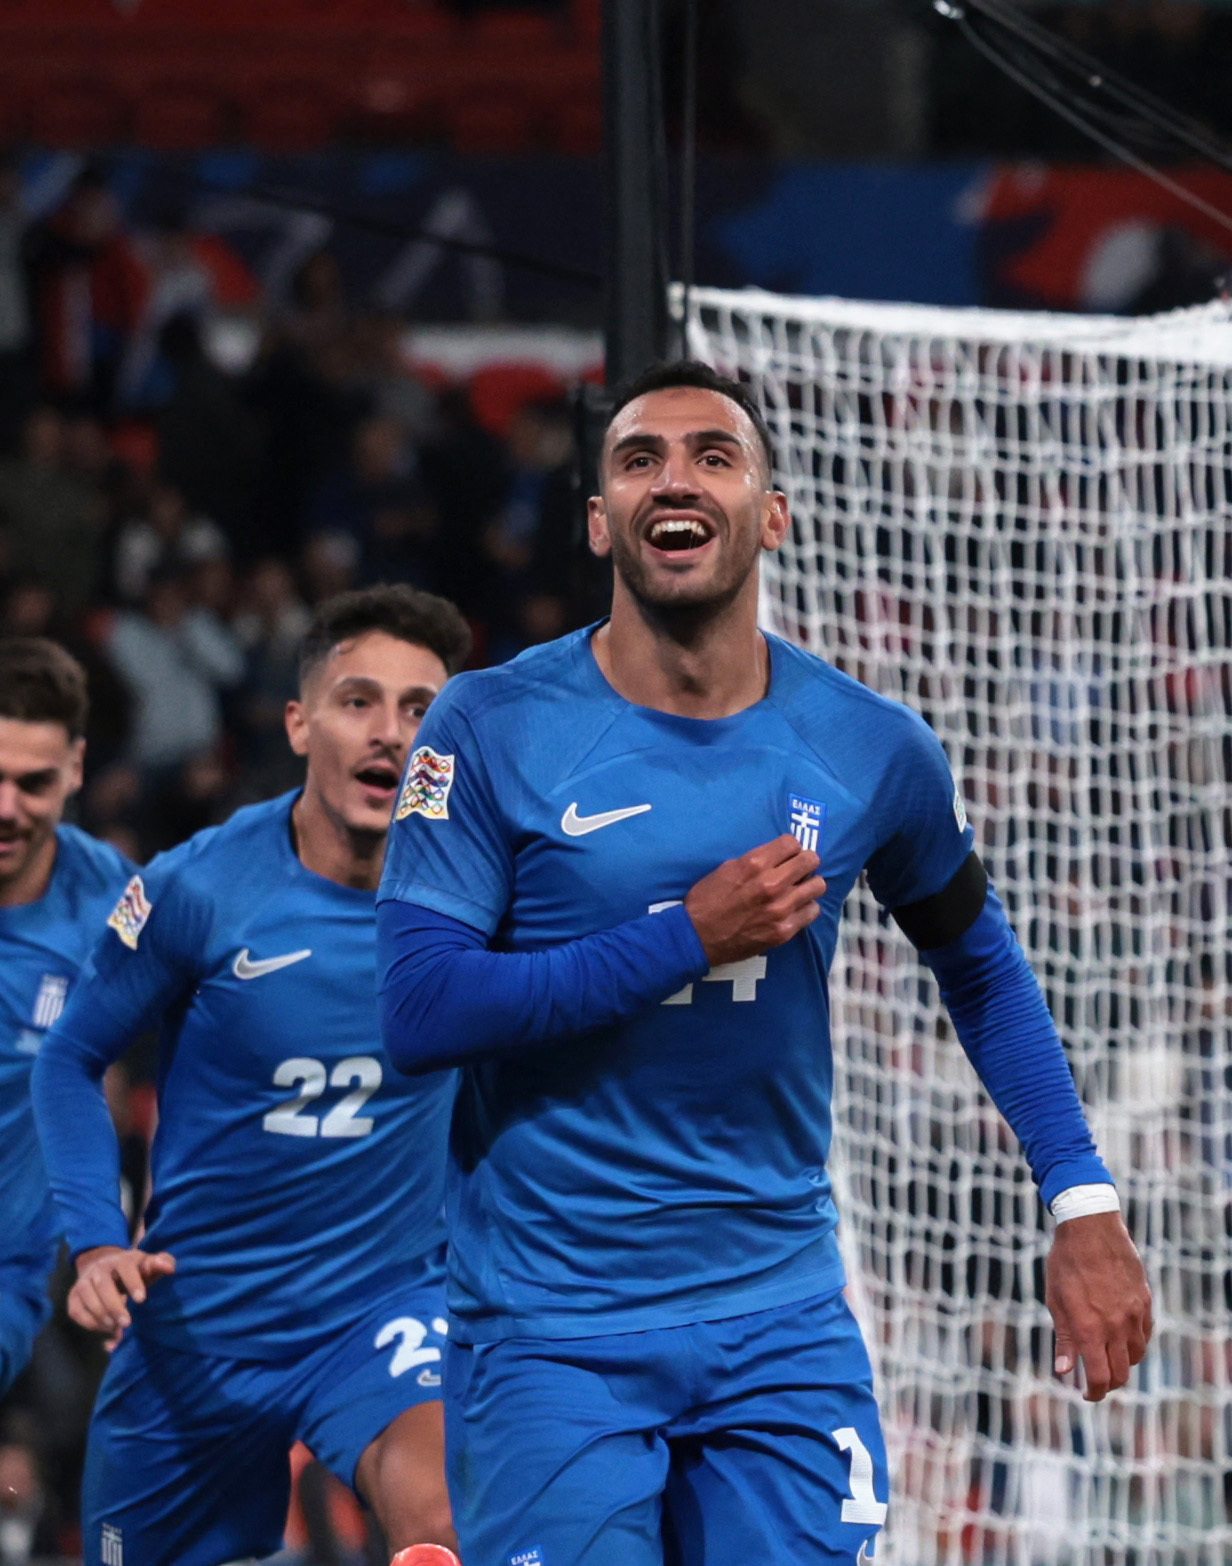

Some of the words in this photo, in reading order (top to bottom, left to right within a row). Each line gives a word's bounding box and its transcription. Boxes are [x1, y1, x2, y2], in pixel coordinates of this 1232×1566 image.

[648, 900, 767, 1005] 4
[263, 1056, 382, 1138] 22
[374, 1316, 449, 1378] 2
[831, 1427, 888, 1526] 1
